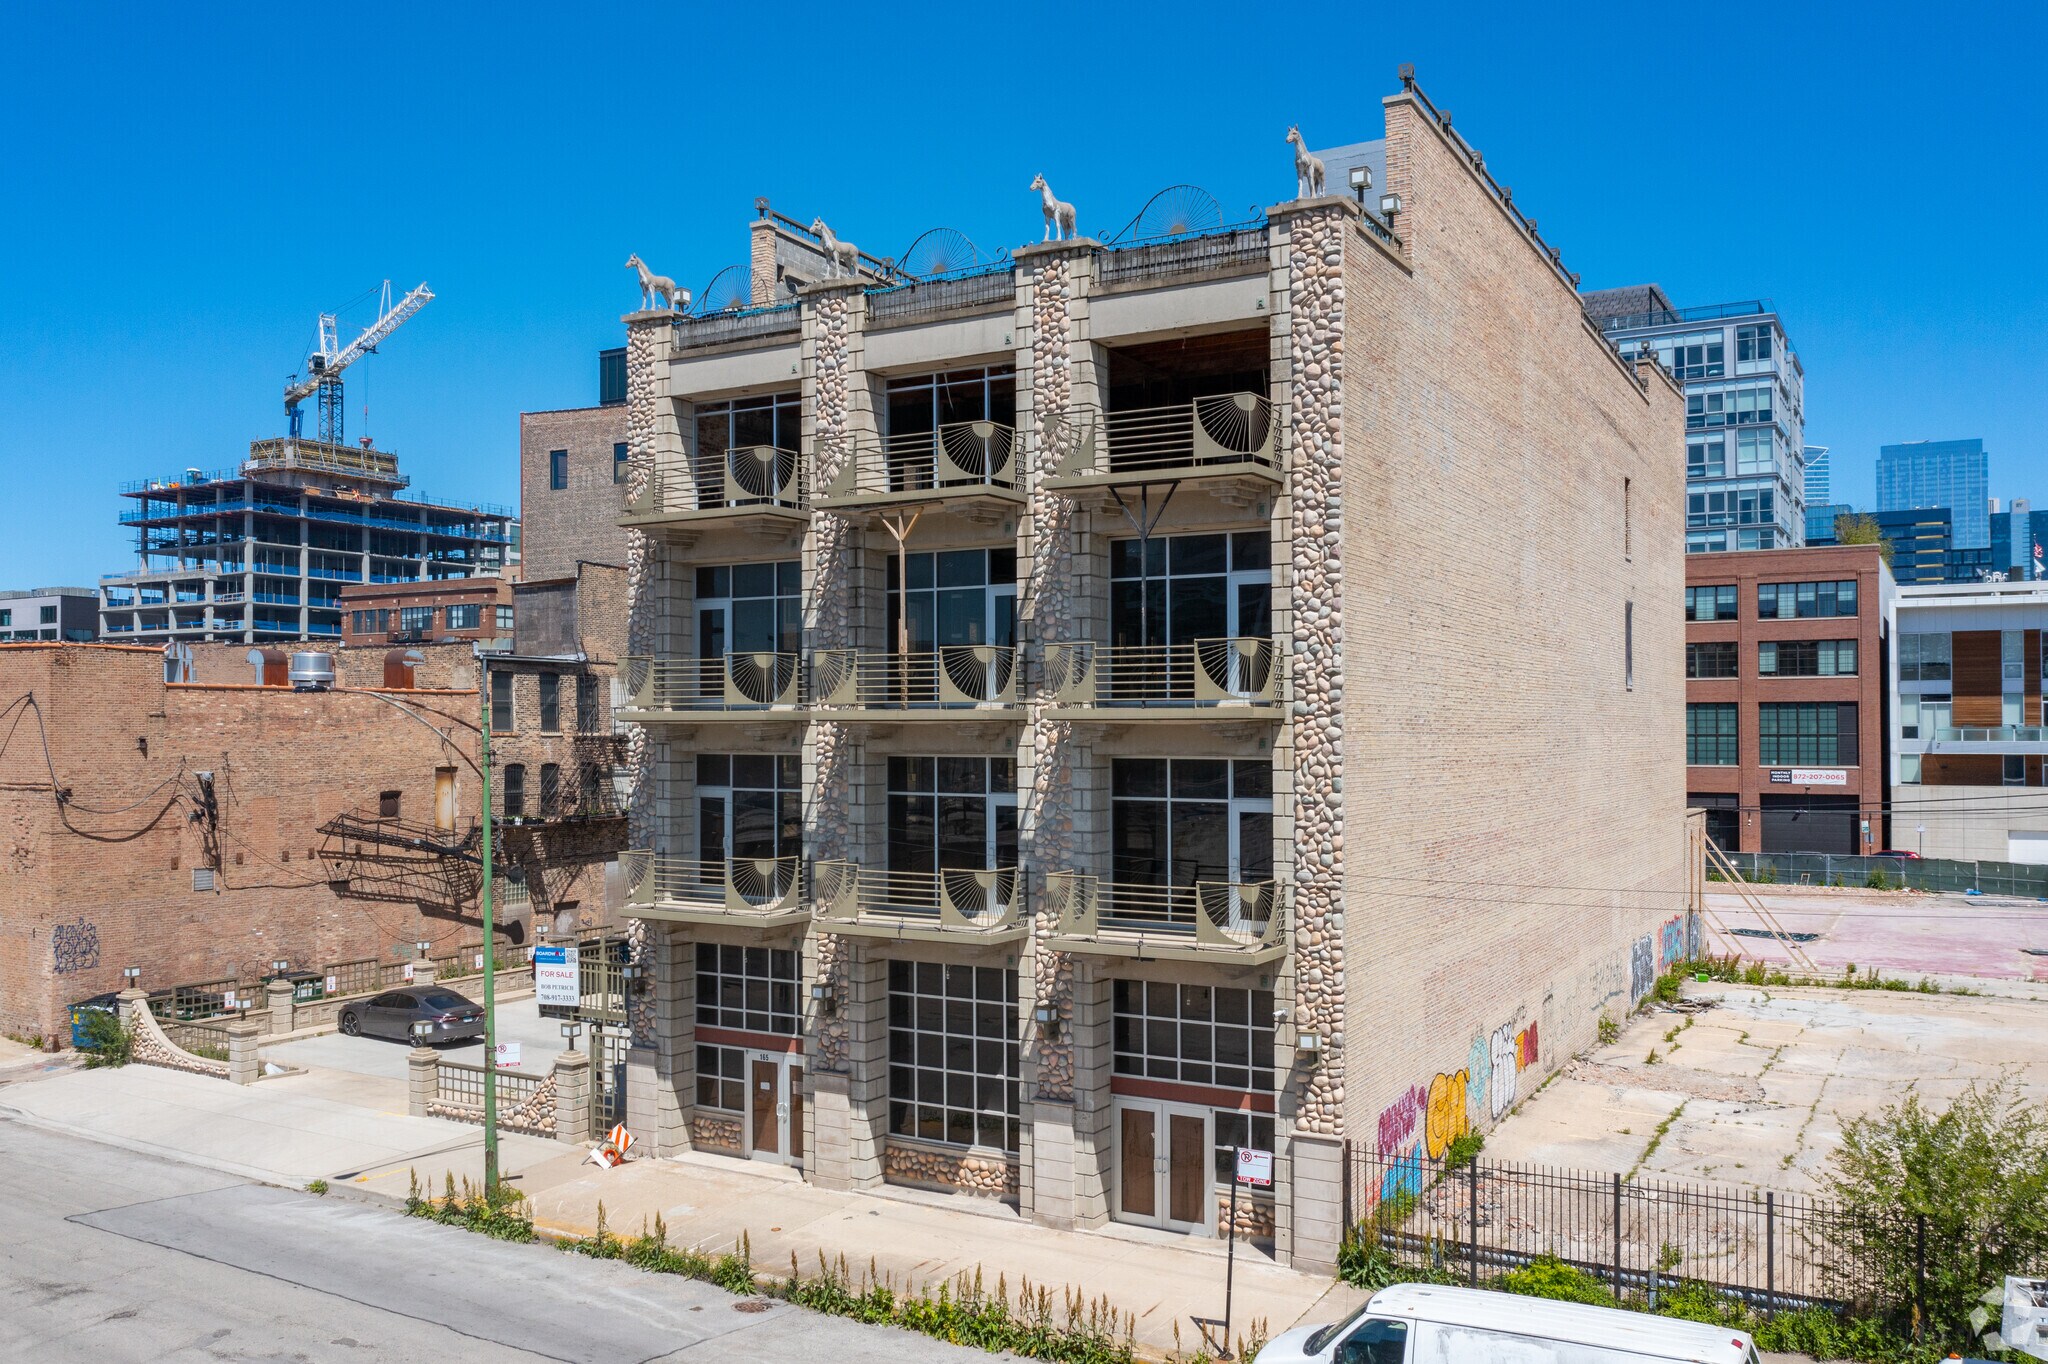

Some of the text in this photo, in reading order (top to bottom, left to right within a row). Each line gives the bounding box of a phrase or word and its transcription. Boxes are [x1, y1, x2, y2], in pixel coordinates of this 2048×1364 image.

[1793, 773, 1845, 781] 872-207-0065
[540, 970, 574, 979] FOR SALE
[541, 993, 575, 1002] 708-917-3333
